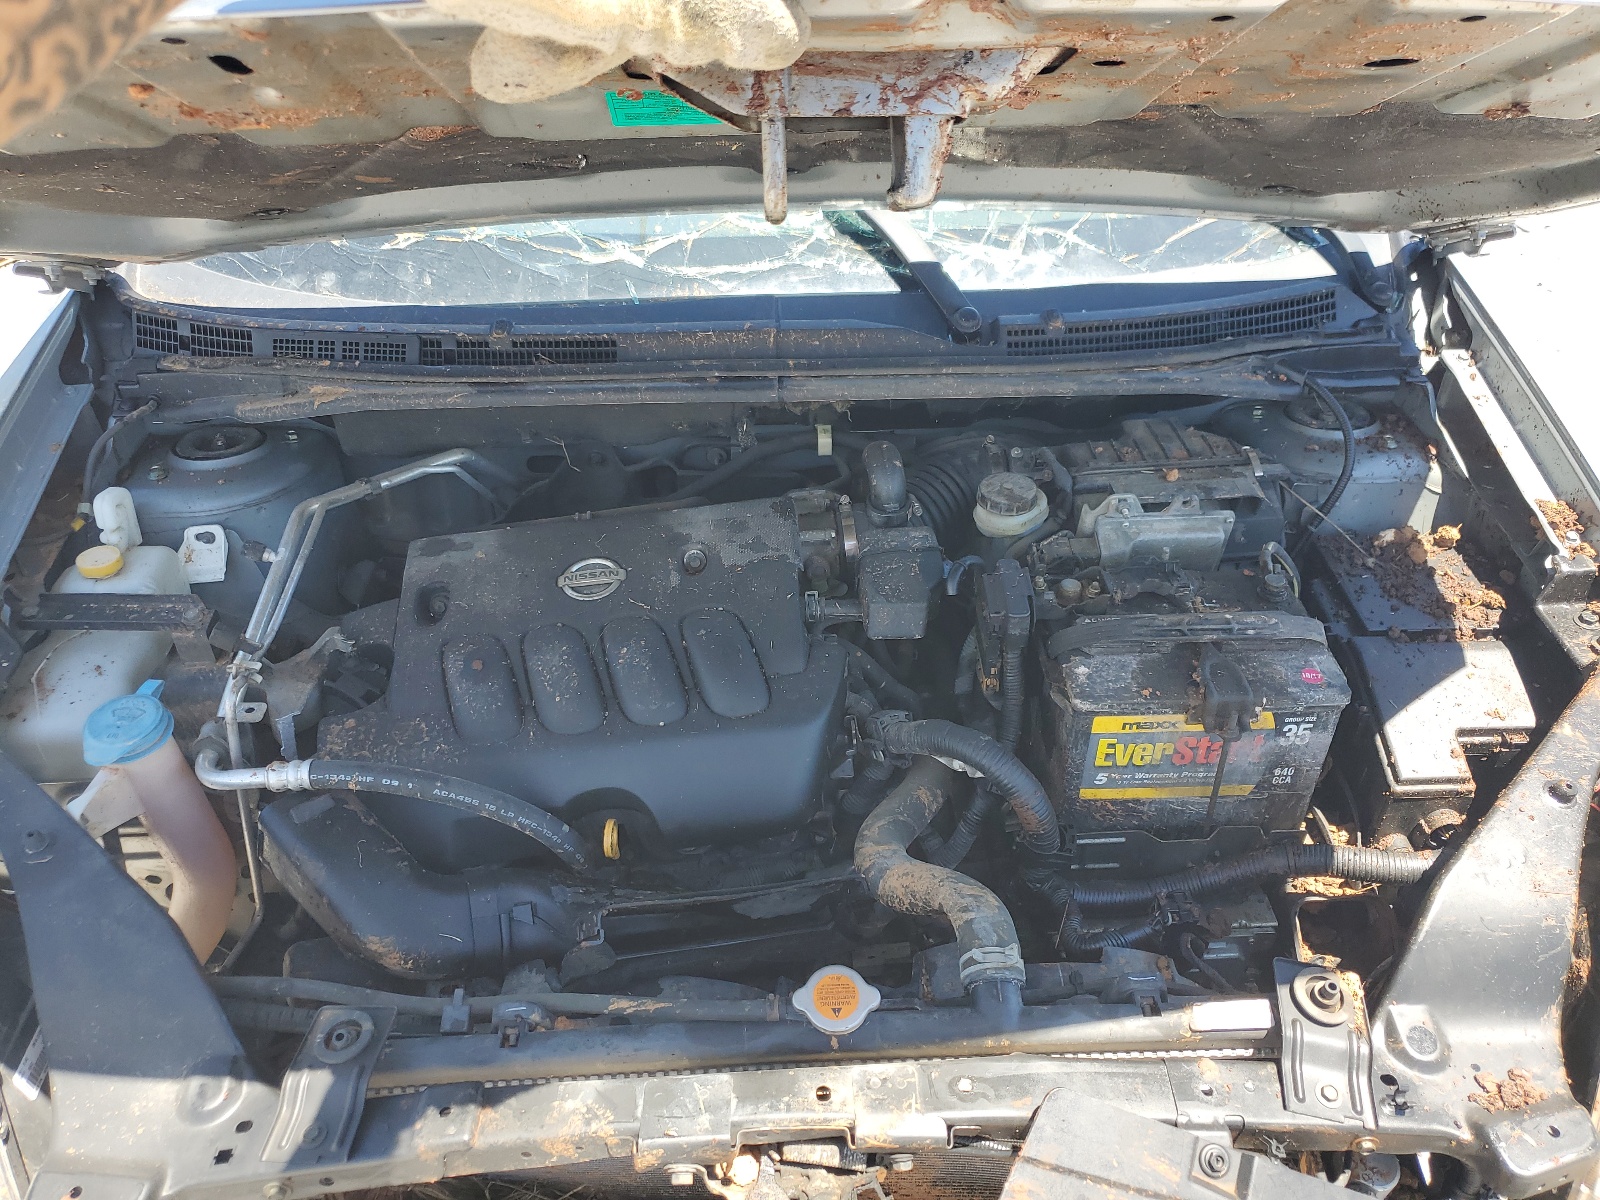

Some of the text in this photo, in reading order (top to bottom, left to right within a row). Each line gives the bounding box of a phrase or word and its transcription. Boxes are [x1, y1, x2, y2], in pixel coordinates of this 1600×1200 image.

[563, 569, 620, 583] NISSAN
[1121, 720, 1180, 731] maxx
[1280, 723, 1314, 745] 35
[1274, 767, 1295, 776] 640
[381, 778, 400, 787] 09
[1093, 772, 1109, 785] 5
[1272, 776, 1292, 784] CCA
[820, 1000, 852, 1008] WARNING
